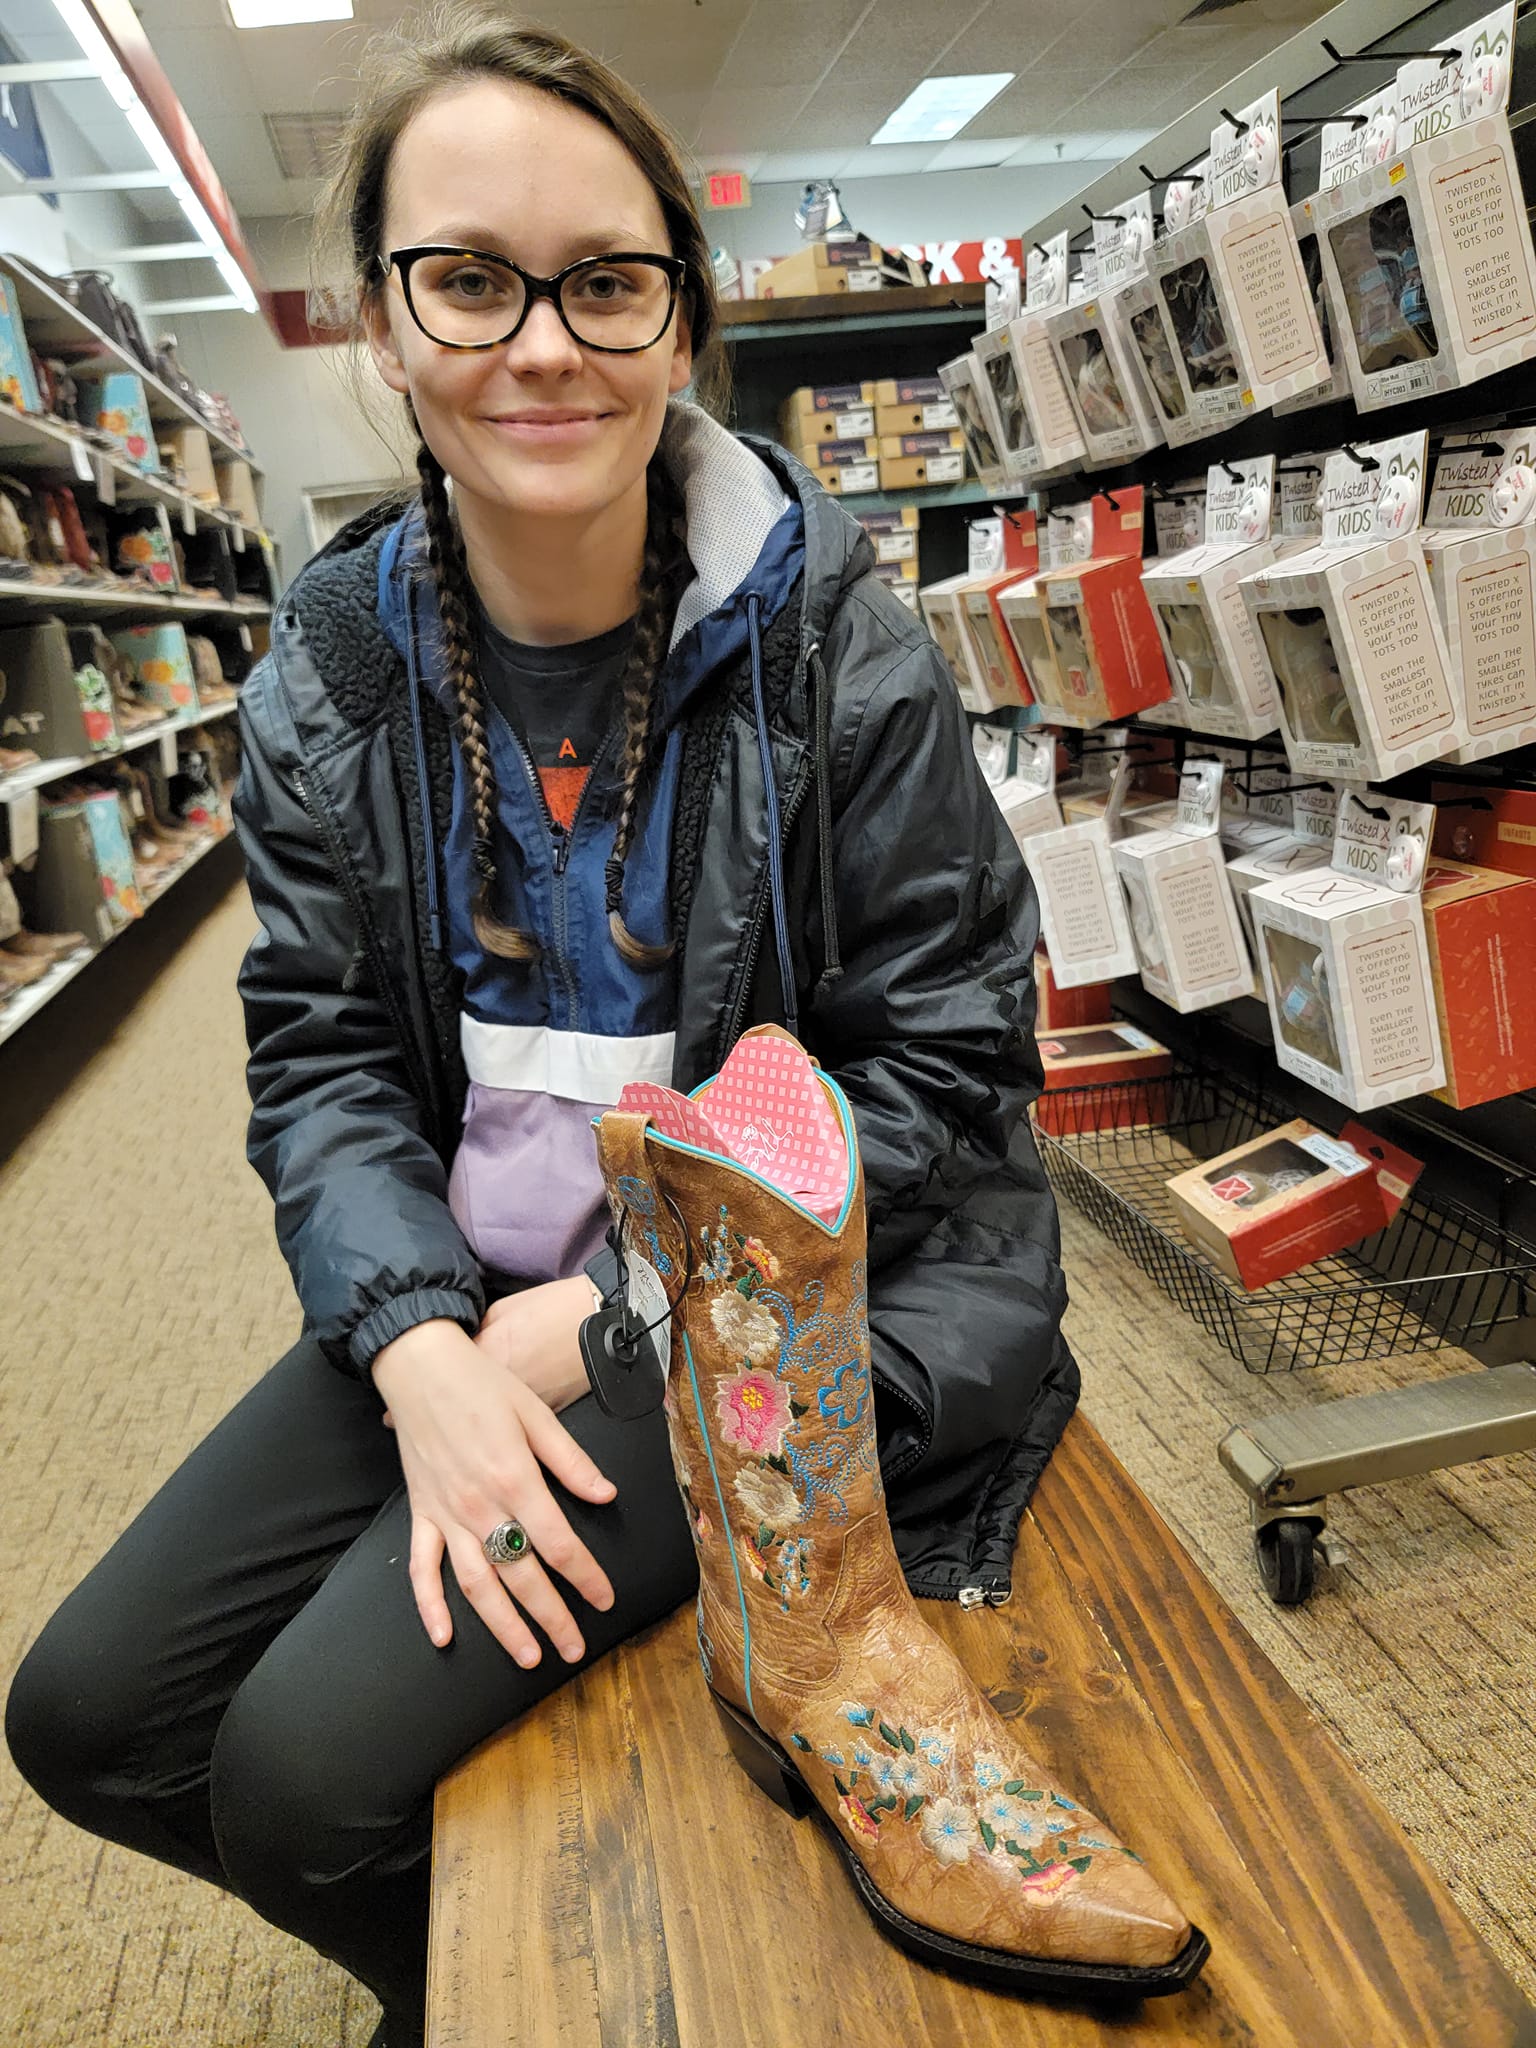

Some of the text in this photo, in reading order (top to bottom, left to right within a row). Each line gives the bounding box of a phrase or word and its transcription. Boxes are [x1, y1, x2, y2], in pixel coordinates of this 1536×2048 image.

[1401, 68, 1449, 113] Twisted
[1452, 64, 1464, 85] X
[1414, 103, 1452, 144] KIDS
[1223, 166, 1246, 198] KIDS
[1440, 461, 1503, 481] Twisted X
[1328, 476, 1369, 503] Twisted
[1293, 503, 1317, 523] KIDS
[1445, 493, 1485, 517] KIDS
[1215, 512, 1238, 532] KIDS
[1337, 508, 1372, 537] KIDS
[558, 737, 578, 759] A
[1305, 815, 1333, 838] KIDS
[1341, 817, 1390, 842] Twisted X
[1346, 845, 1378, 873] KIDS
